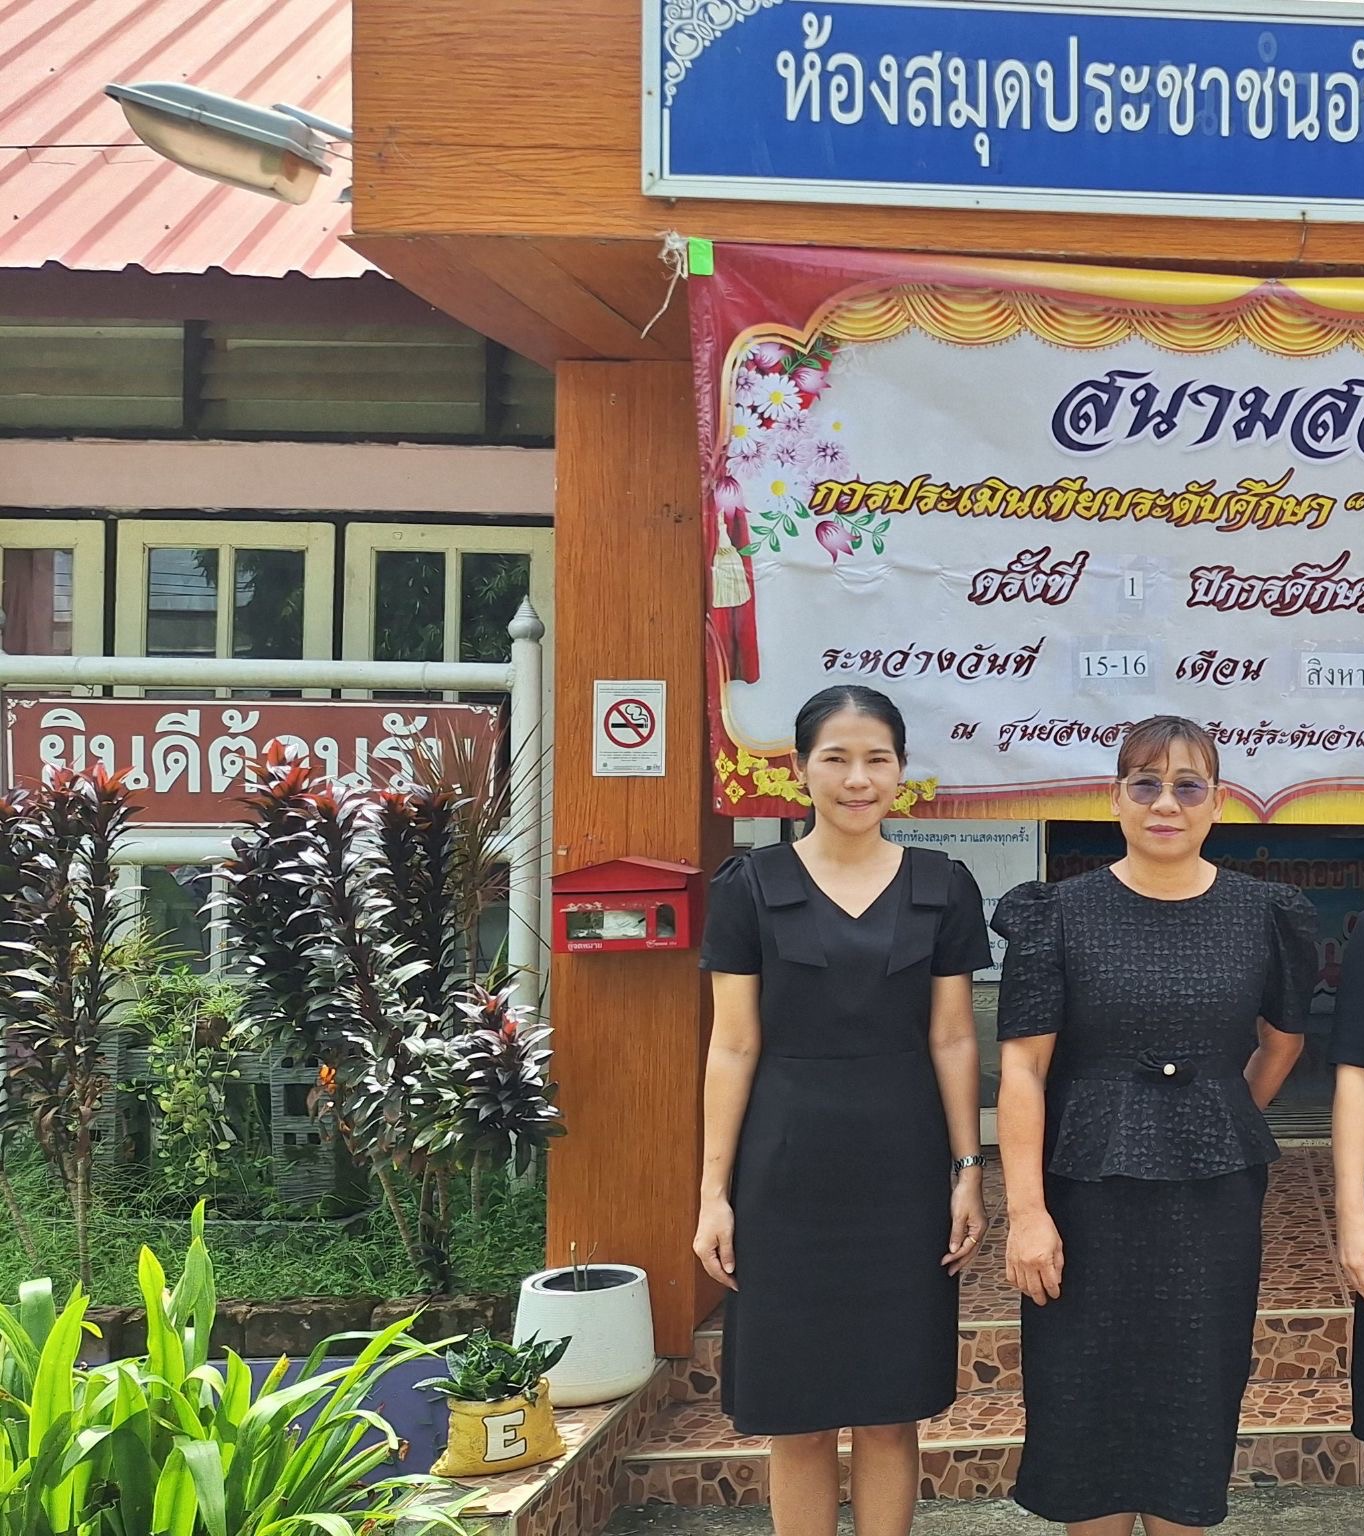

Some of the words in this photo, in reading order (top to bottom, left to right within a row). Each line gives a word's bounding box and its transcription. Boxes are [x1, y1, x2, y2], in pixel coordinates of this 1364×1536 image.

[968, 546, 1090, 607] ครั้งที่
[1127, 576, 1137, 597] 1
[821, 636, 1047, 682] ระหว่างวันที่
[1083, 655, 1147, 677] 15-16
[1175, 650, 1270, 685] เดือน
[950, 721, 981, 740] ณ
[960, 827, 1030, 847] มาแสดงทุกครั้ง
[482, 1409, 527, 1462] E
